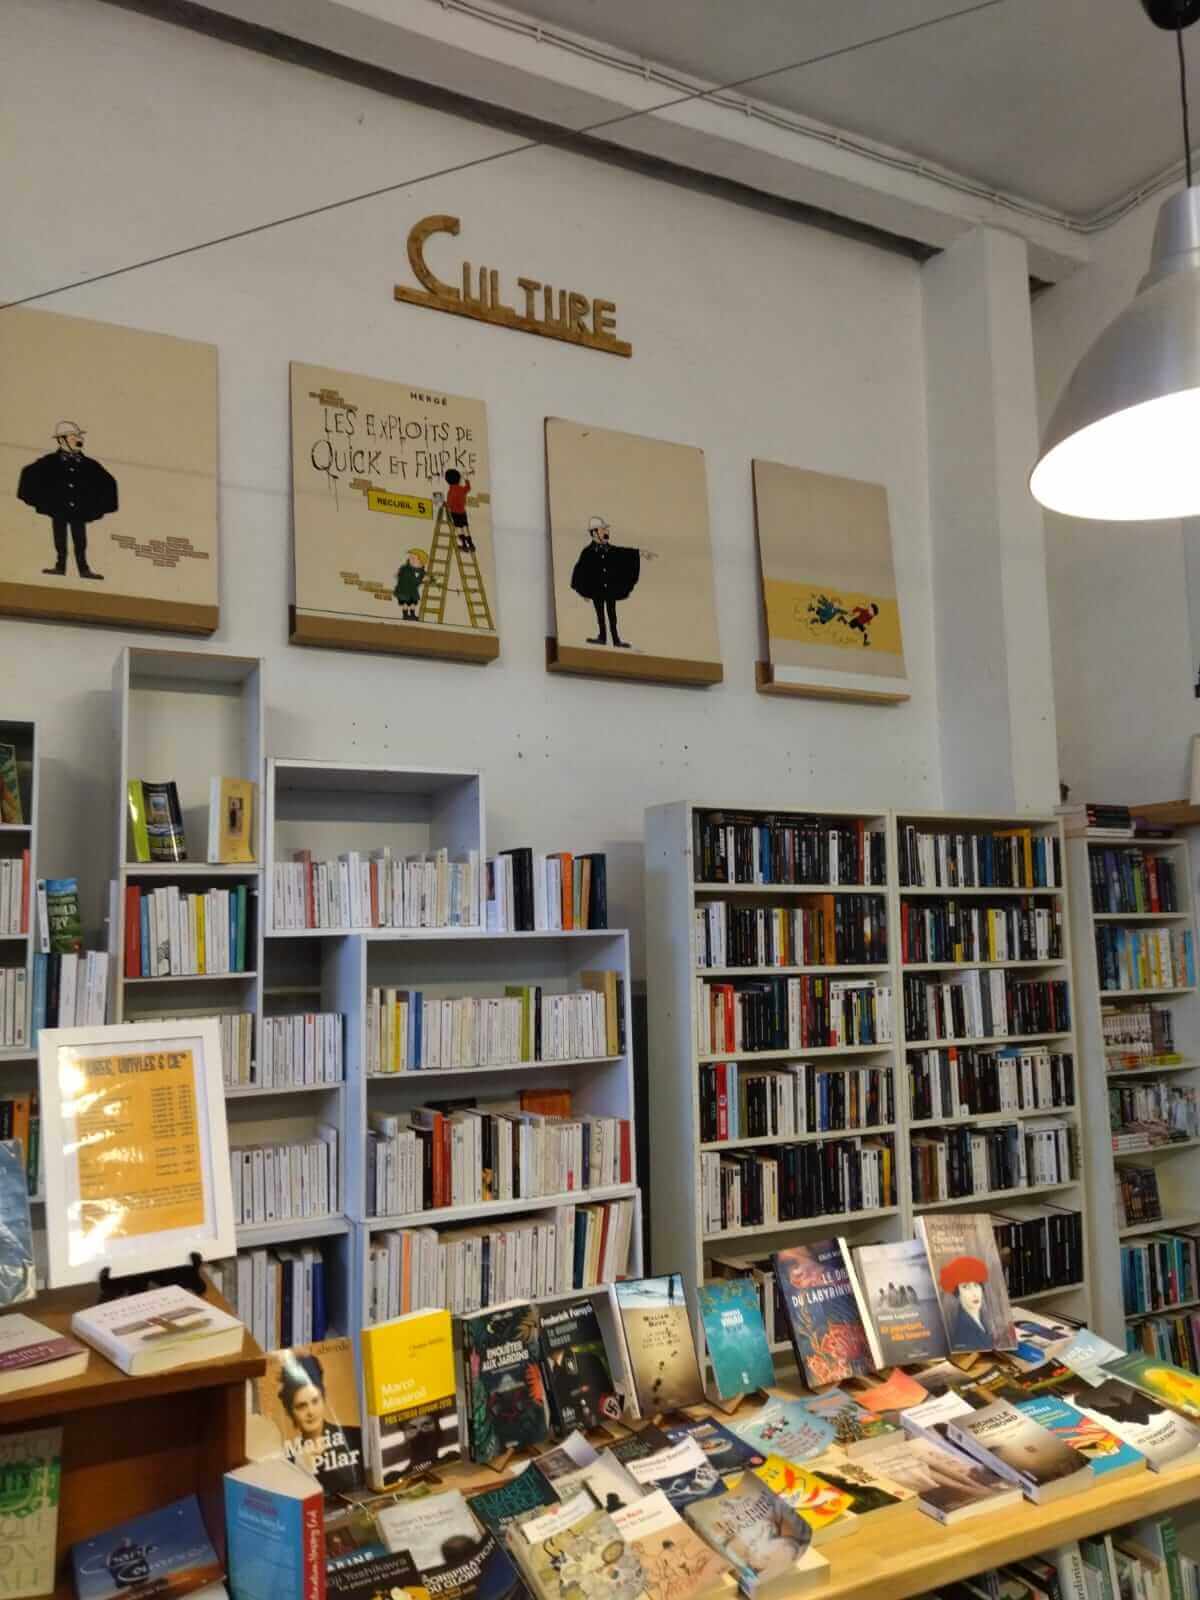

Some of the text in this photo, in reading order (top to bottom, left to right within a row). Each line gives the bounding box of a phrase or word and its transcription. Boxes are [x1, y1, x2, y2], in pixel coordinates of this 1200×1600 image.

[407, 214, 617, 337] CULTURE
[410, 391, 448, 406] HERGÉ
[324, 408, 357, 436] LES
[455, 426, 473, 441] DE
[389, 456, 408, 480] ET
[377, 496, 426, 513] RECUEIL 5
[482, 1358, 497, 1372] AUX
[312, 1449, 360, 1475] Pilar
